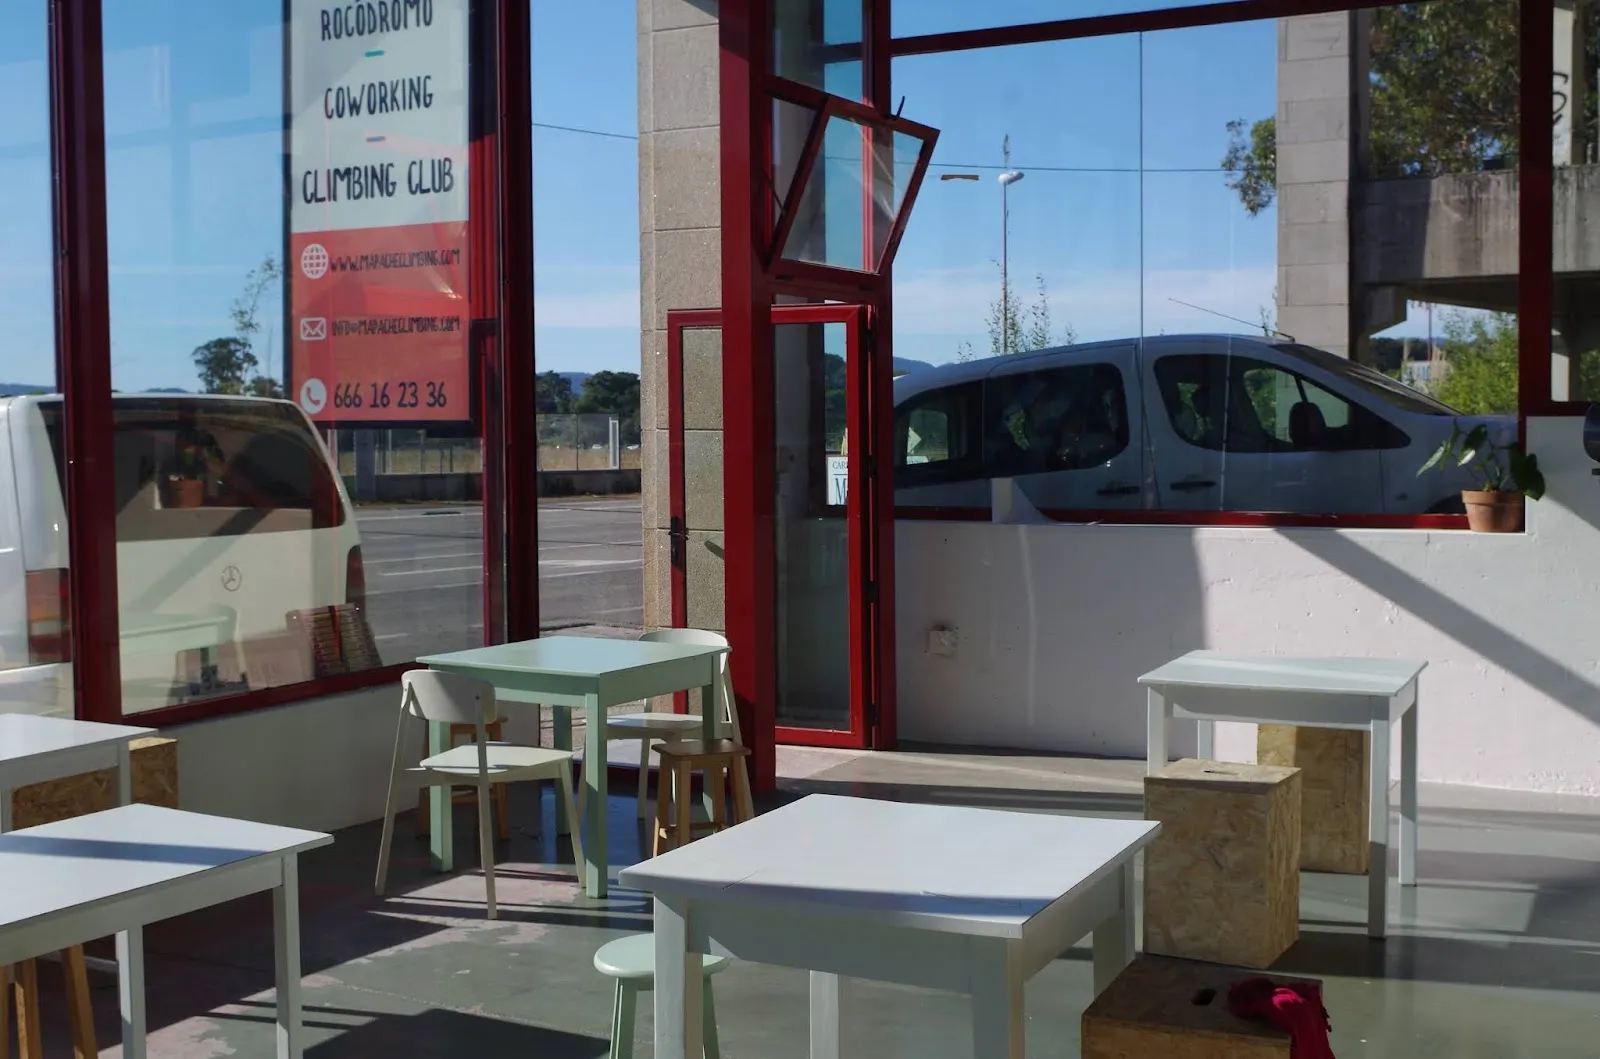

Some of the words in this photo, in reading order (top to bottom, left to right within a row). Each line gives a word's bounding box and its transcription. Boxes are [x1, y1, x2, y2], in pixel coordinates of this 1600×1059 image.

[324, 75, 433, 119] COWORKING
[302, 163, 397, 204] CLIMBING
[407, 157, 454, 195] CLUB
[334, 382, 362, 408] 666
[369, 382, 390, 408] 16
[398, 381, 419, 407] 23
[426, 381, 447, 407] 36
[832, 460, 848, 470] CAR
